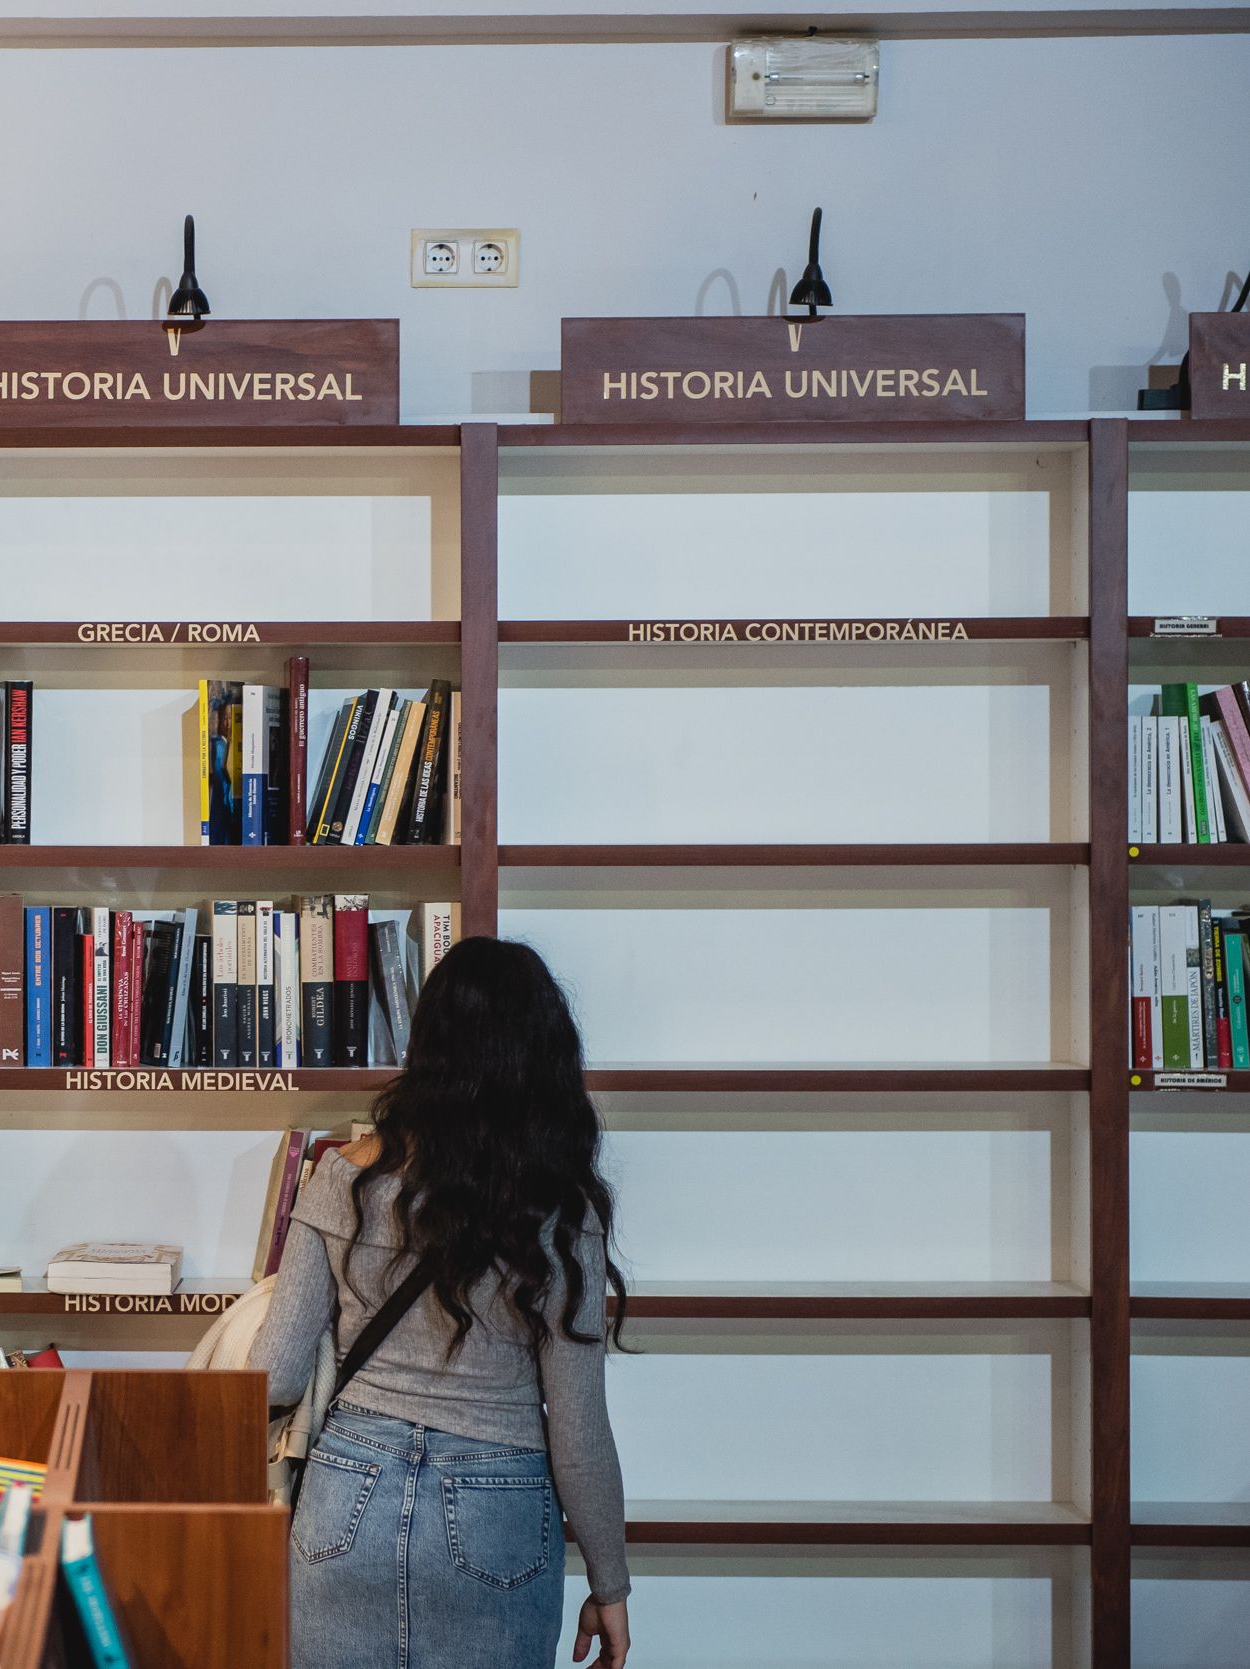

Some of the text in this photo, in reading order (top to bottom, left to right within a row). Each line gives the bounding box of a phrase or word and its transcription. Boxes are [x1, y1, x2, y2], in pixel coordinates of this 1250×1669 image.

[163, 373, 363, 401] UNIVERSAL
[603, 368, 988, 400] HISTORIA UNIVERSAL
[1221, 363, 1249, 390] H
[77, 623, 261, 642] GRECIA / ROMA
[628, 619, 969, 642] HISTORIA CONTEMPORÁNEA
[11, 689, 26, 728] KERSHAW
[297, 684, 306, 710] antiguo
[11, 729, 26, 743] IAN
[298, 711, 307, 739] guerrero
[348, 705, 363, 740] VIKINGOS
[11, 744, 27, 768] PODER
[416, 710, 440, 822] HISTORIA DE LAS IDEAS CONTEMPORÁNEAS
[11, 776, 27, 830] PERSONALIDAD
[216, 937, 224, 977] Los árboles
[318, 955, 323, 964] LA
[318, 967, 323, 975] EN
[316, 987, 325, 1026] GILDEA
[1192, 997, 1199, 1008] DE
[97, 985, 108, 1054] DON GIUSSANI
[1192, 1010, 1200, 1051] MÁRTIRES
[65, 1071, 300, 1091] HISTORIA MEDIEVAL
[64, 1294, 242, 1313] HISTORIA MOD
